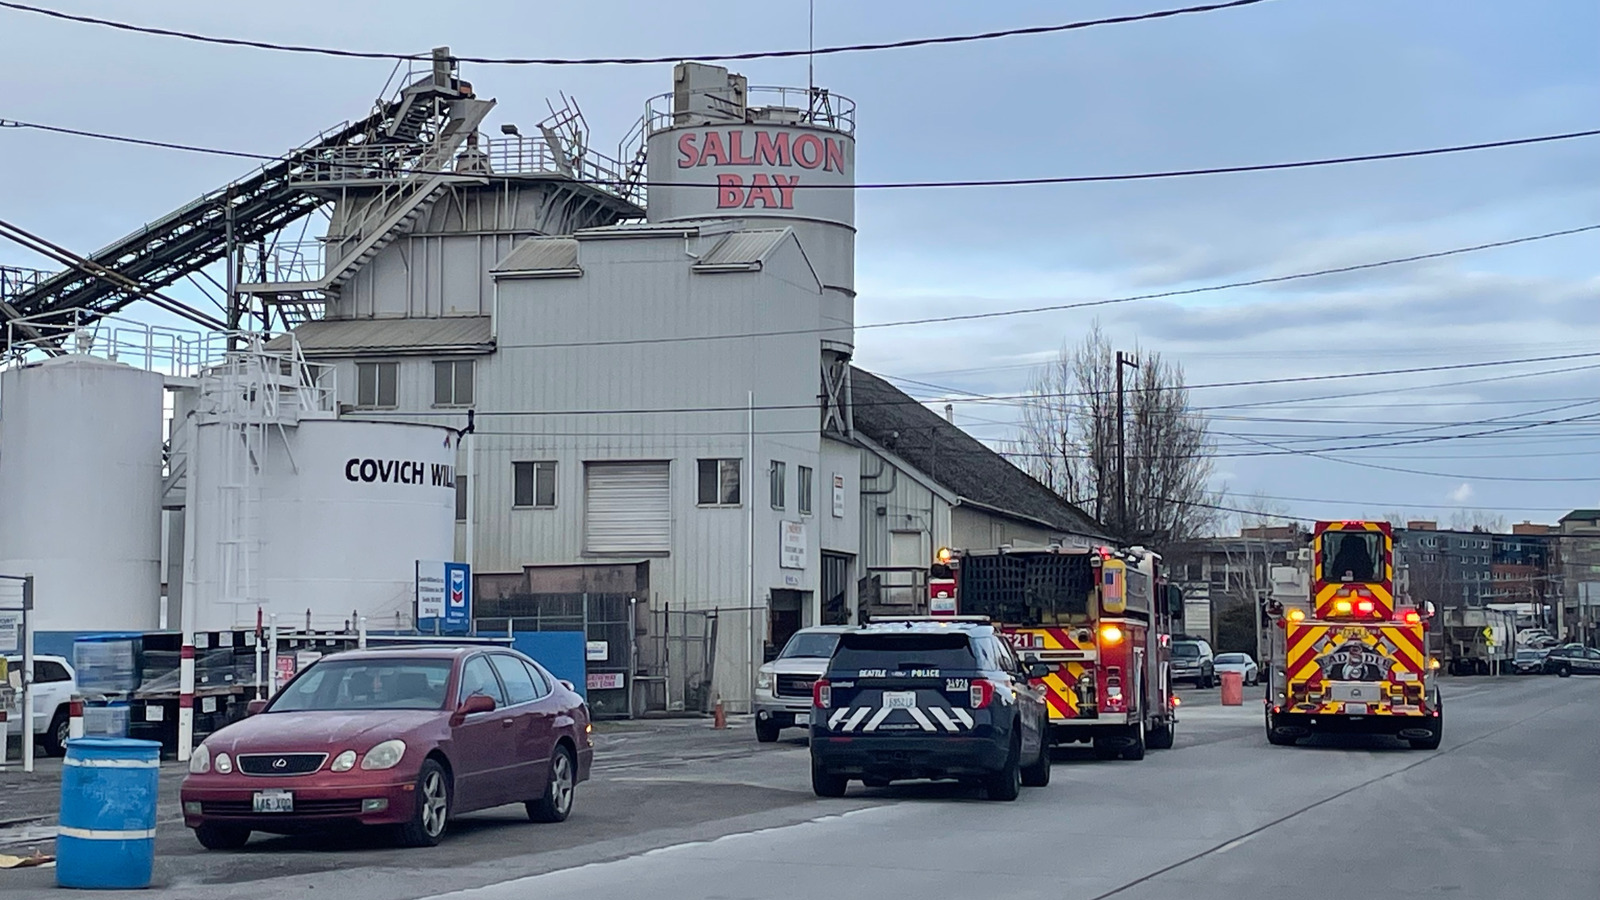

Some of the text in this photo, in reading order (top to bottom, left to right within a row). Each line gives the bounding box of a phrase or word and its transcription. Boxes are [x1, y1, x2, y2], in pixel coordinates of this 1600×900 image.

[677, 130, 845, 175] SALMON
[716, 173, 800, 210] BAY
[345, 458, 425, 485] COVICH
[858, 669, 887, 678] SEATTLE
[911, 669, 940, 678] POLICE
